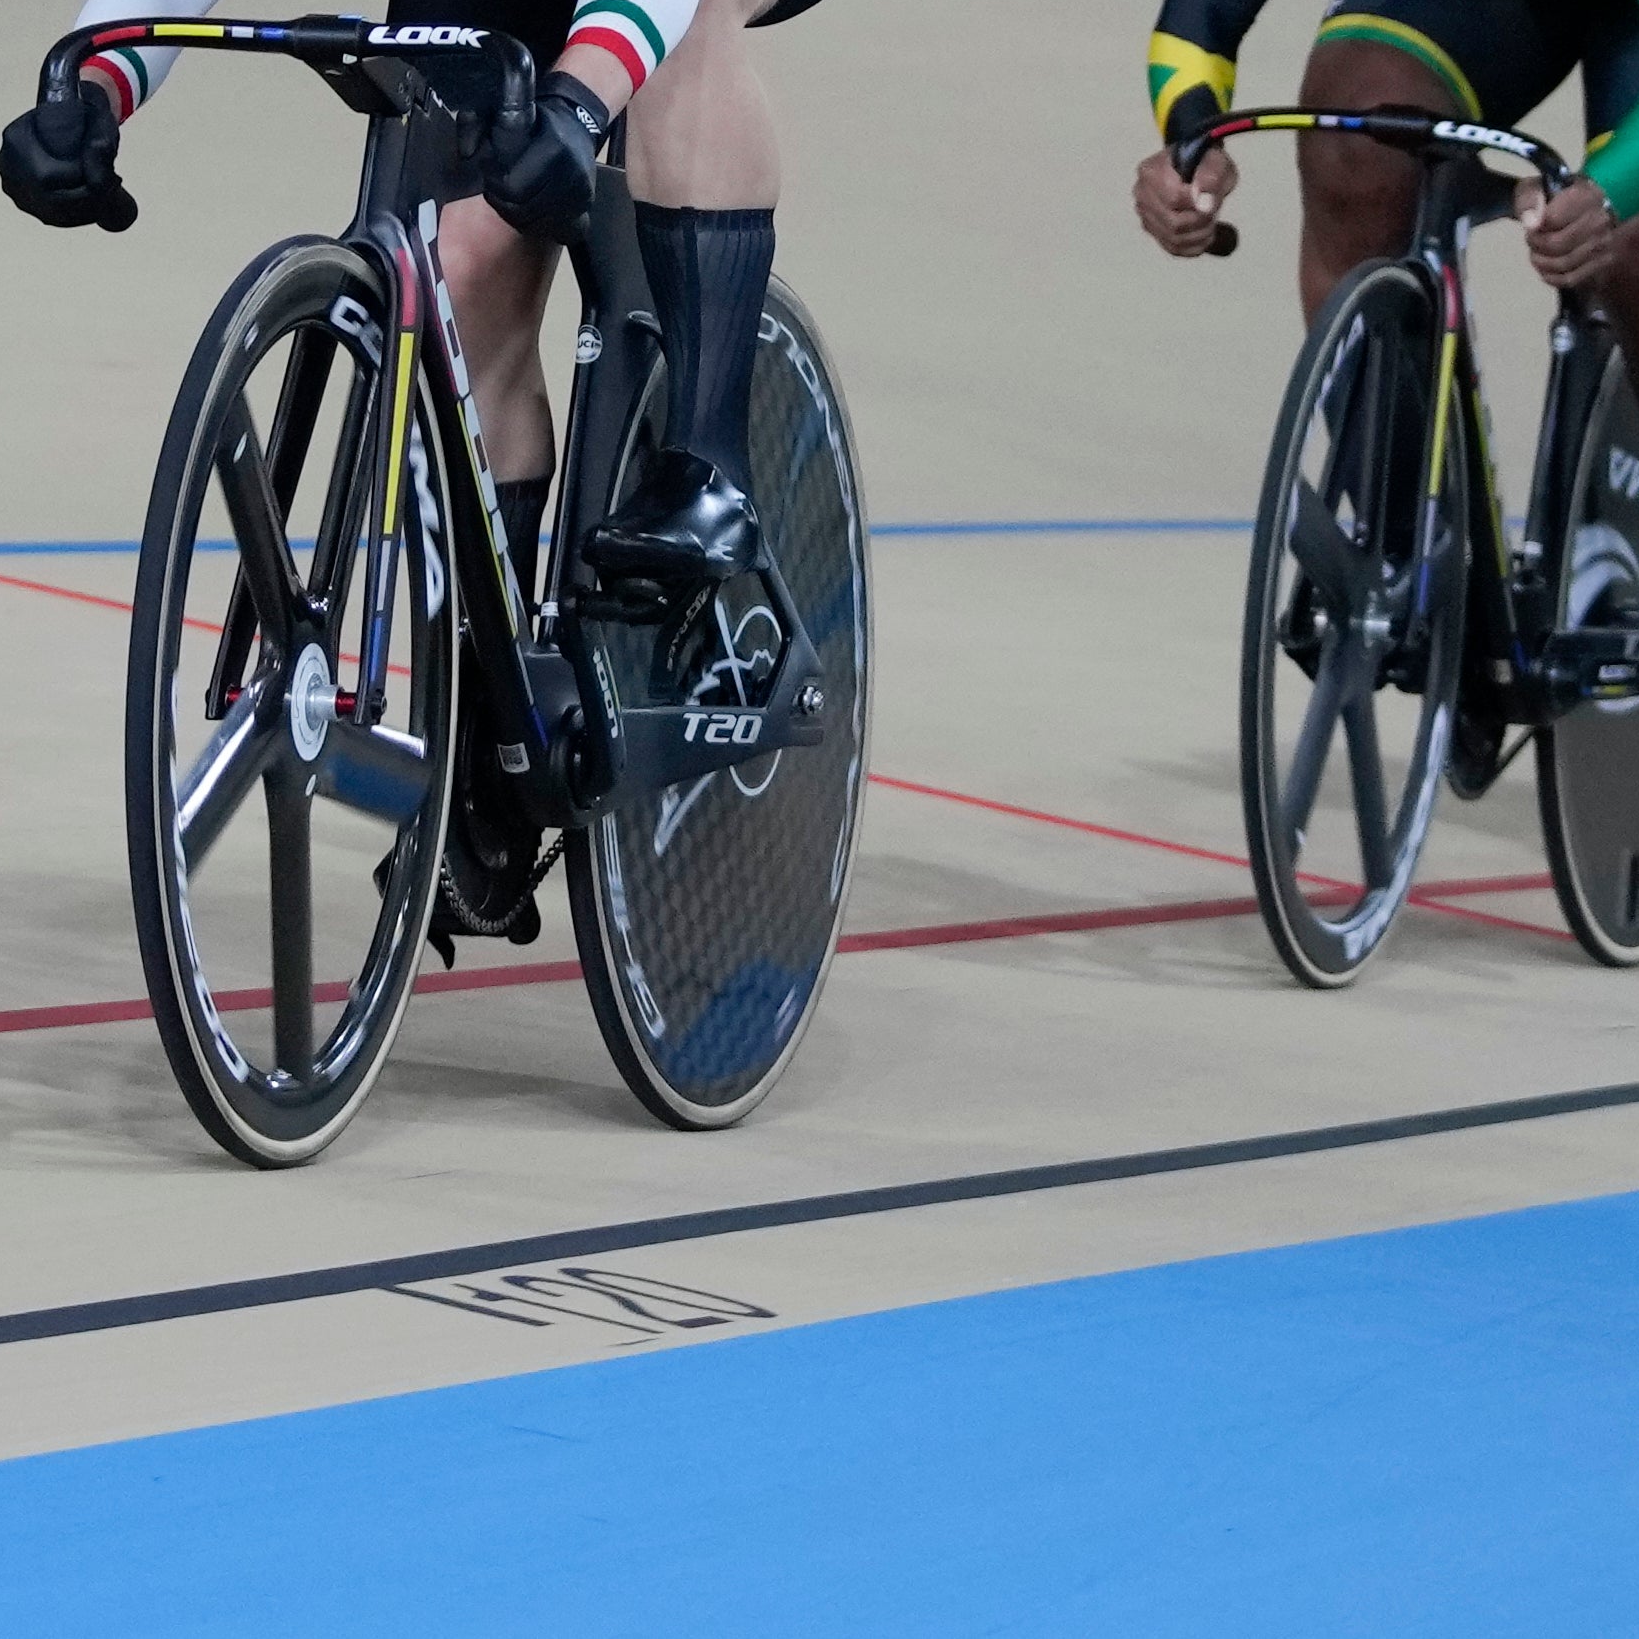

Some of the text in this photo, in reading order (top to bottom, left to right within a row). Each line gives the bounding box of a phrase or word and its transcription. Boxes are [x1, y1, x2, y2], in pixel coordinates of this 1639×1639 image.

[367, 25, 492, 49] LOOK
[1433, 119, 1539, 158] LOOK
[683, 712, 763, 744] T20
